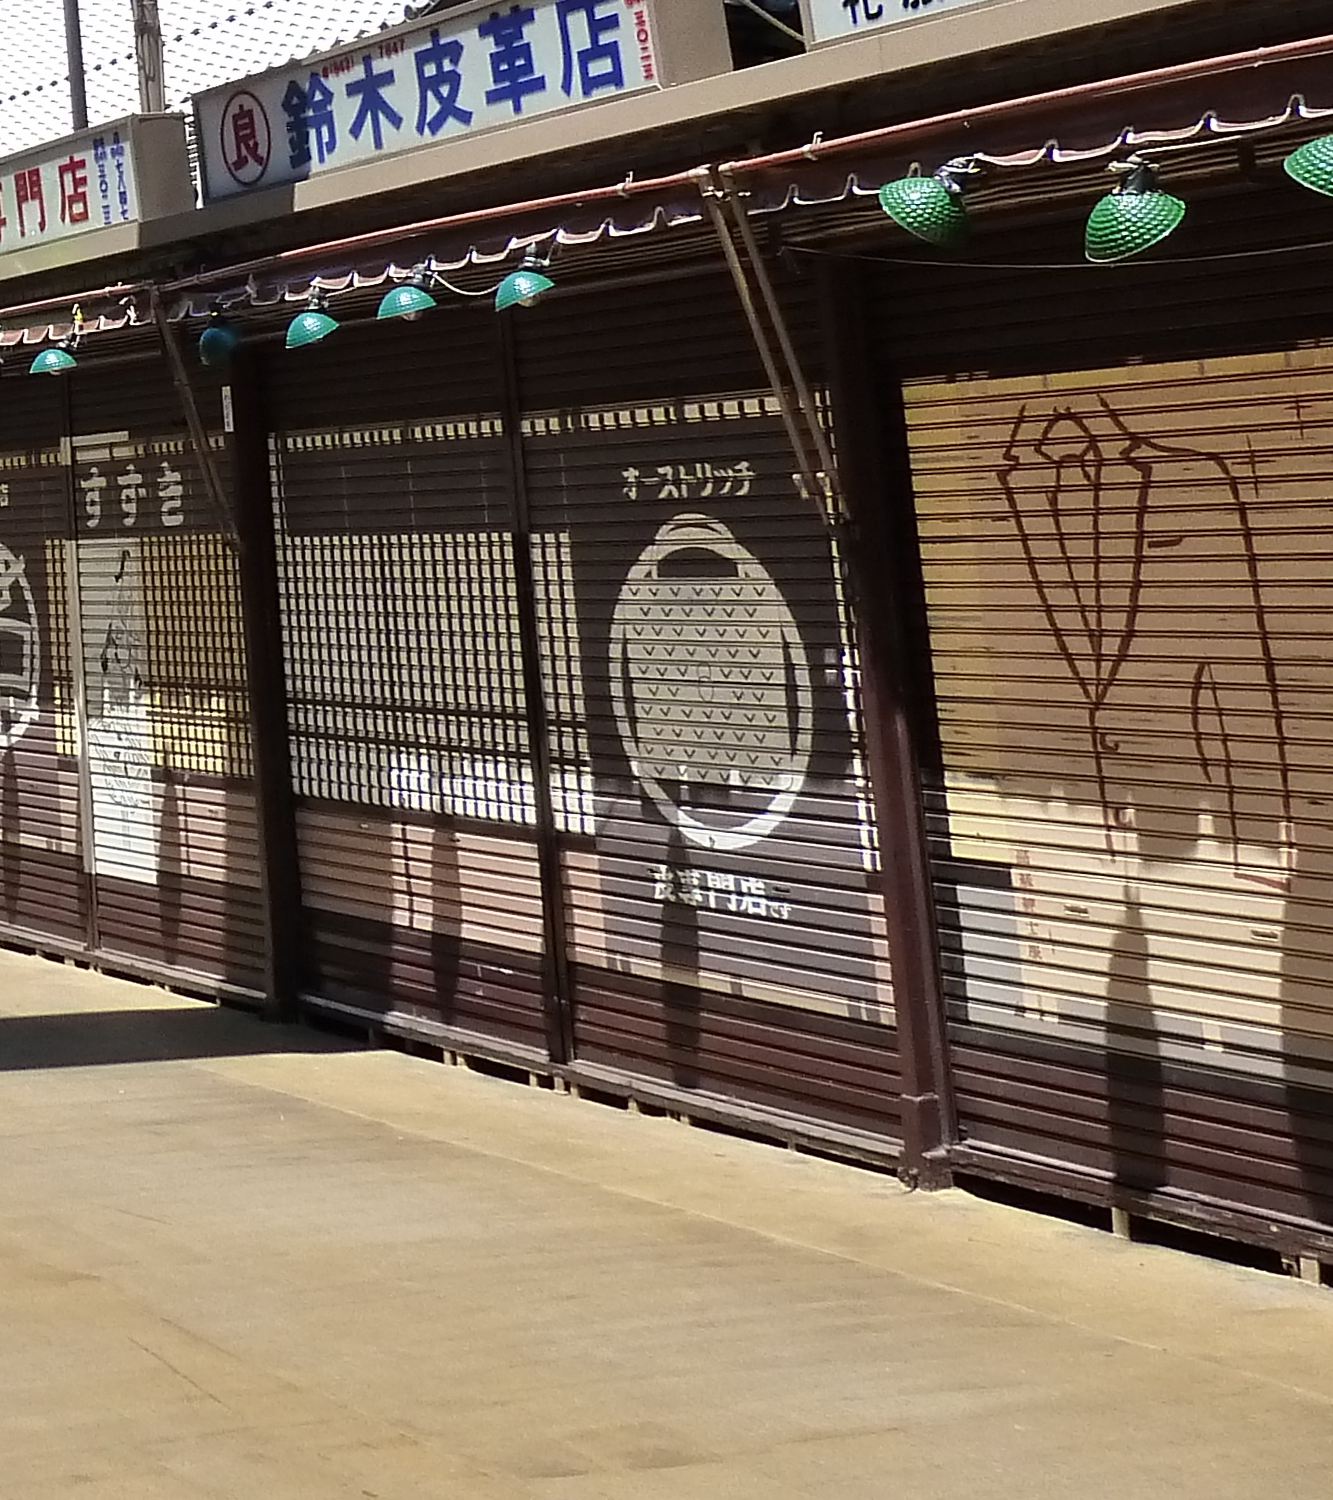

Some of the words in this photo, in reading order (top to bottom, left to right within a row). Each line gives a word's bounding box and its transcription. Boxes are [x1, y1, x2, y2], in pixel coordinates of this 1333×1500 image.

[231, 104, 265, 172] 良
[80, 461, 184, 528] すずき
[621, 461, 756, 500] オーストリッチ
